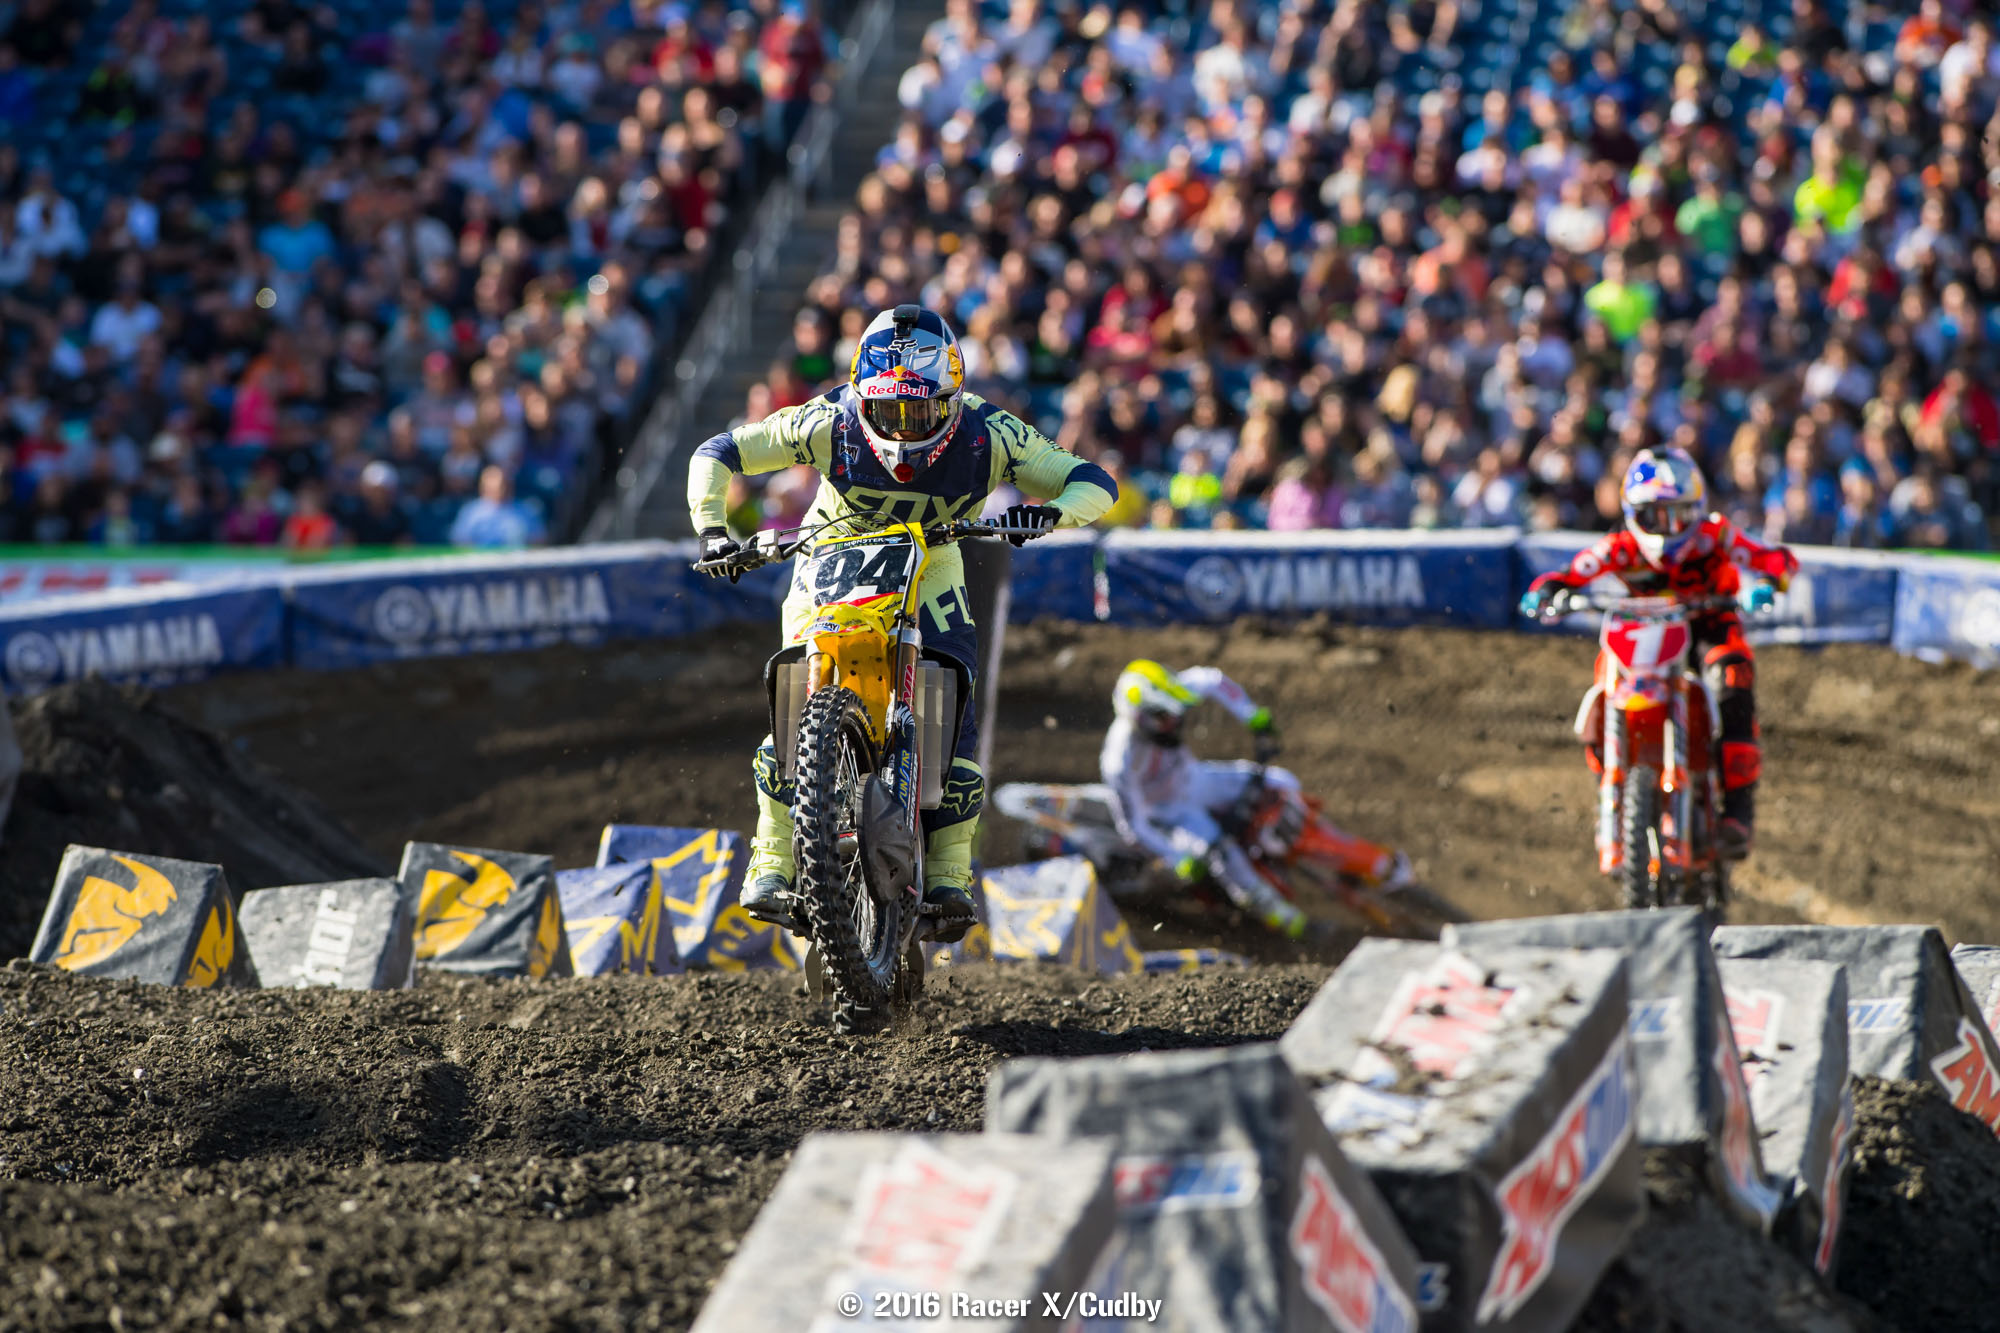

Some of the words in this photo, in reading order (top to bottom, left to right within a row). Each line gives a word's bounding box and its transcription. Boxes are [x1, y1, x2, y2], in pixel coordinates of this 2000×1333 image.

[867, 383, 896, 396] Red
[898, 383, 929, 399] Bull
[844, 485, 972, 530] FOX
[427, 573, 612, 636] YAMAHA
[814, 545, 911, 608] 94
[1240, 556, 1426, 609] YAMAHA
[53, 612, 223, 678] YAMAHA
[1625, 624, 1665, 669] 1
[290, 888, 358, 990] hor
